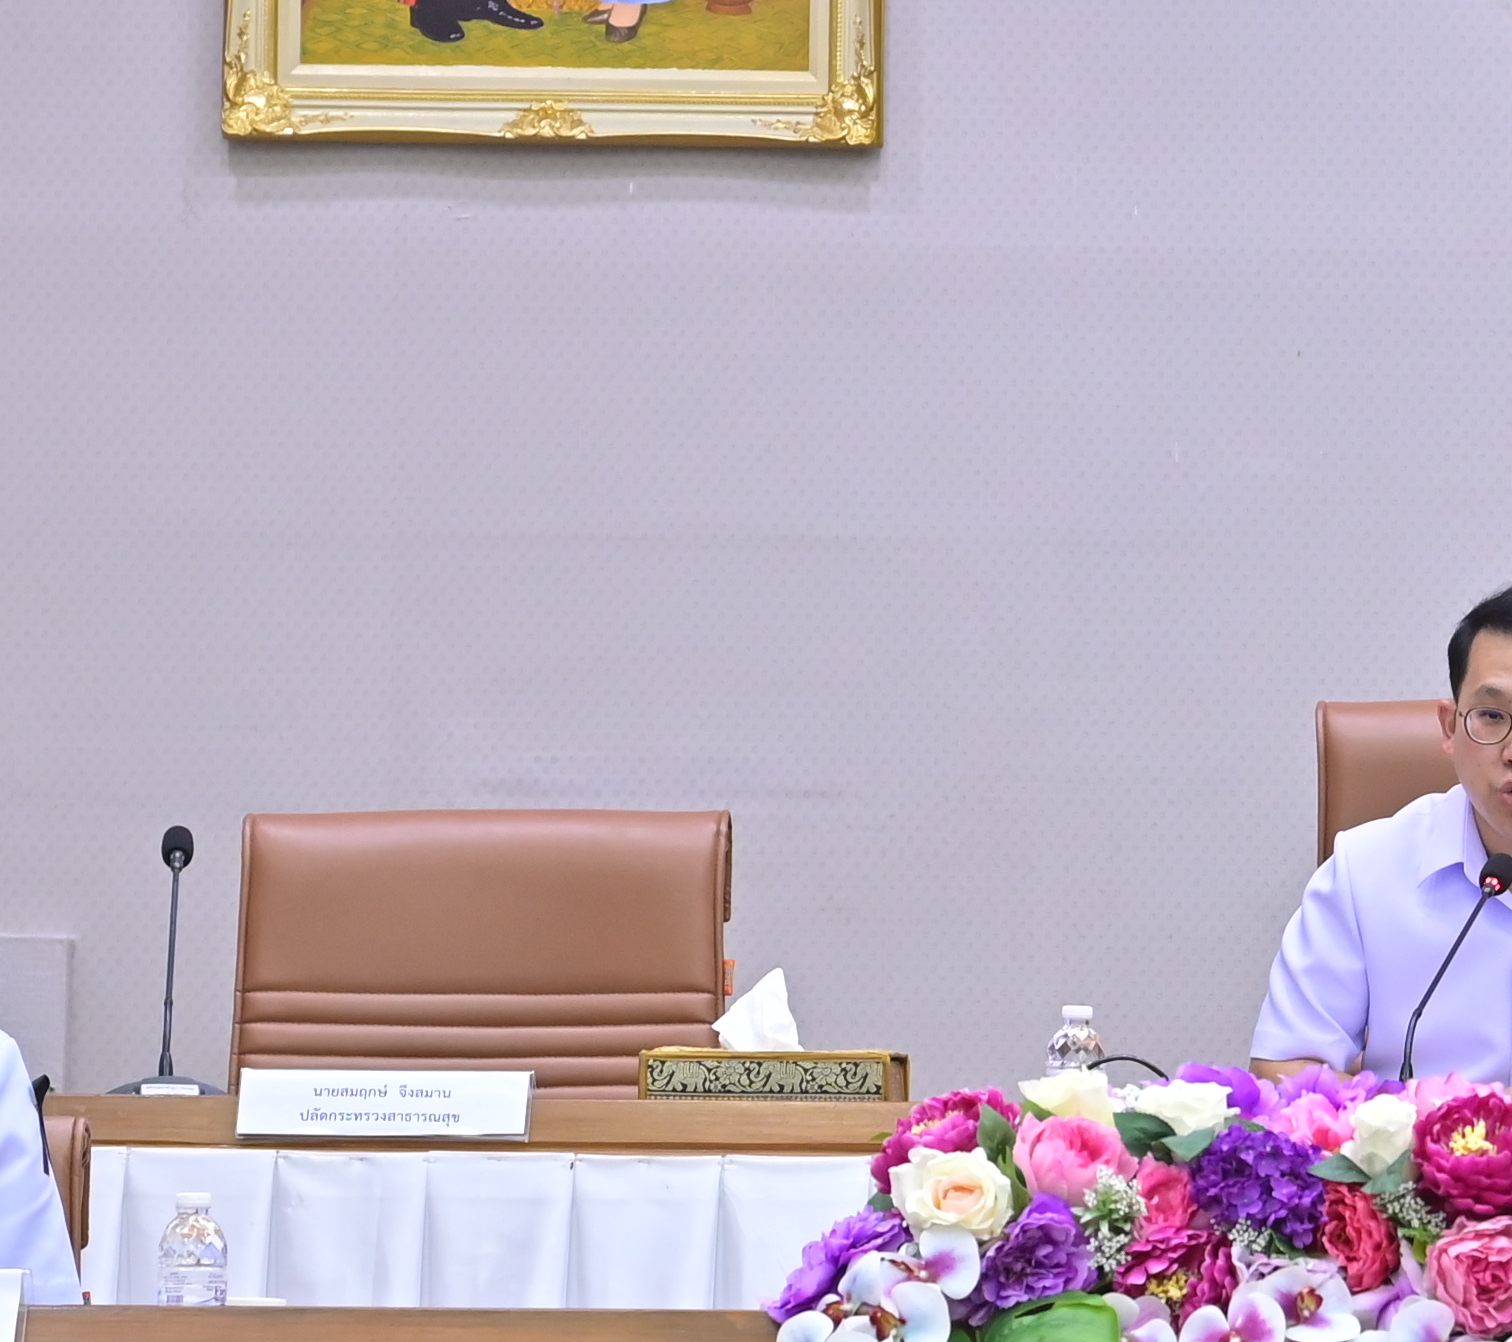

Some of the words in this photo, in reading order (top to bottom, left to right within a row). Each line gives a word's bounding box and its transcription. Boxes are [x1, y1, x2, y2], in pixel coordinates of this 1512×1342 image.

[313, 1084, 388, 1100] นายสมฤกษ์
[399, 1084, 451, 1099] จึงสมาน
[299, 1108, 460, 1127] ปลัดกระทรวงสาธารณสุข
